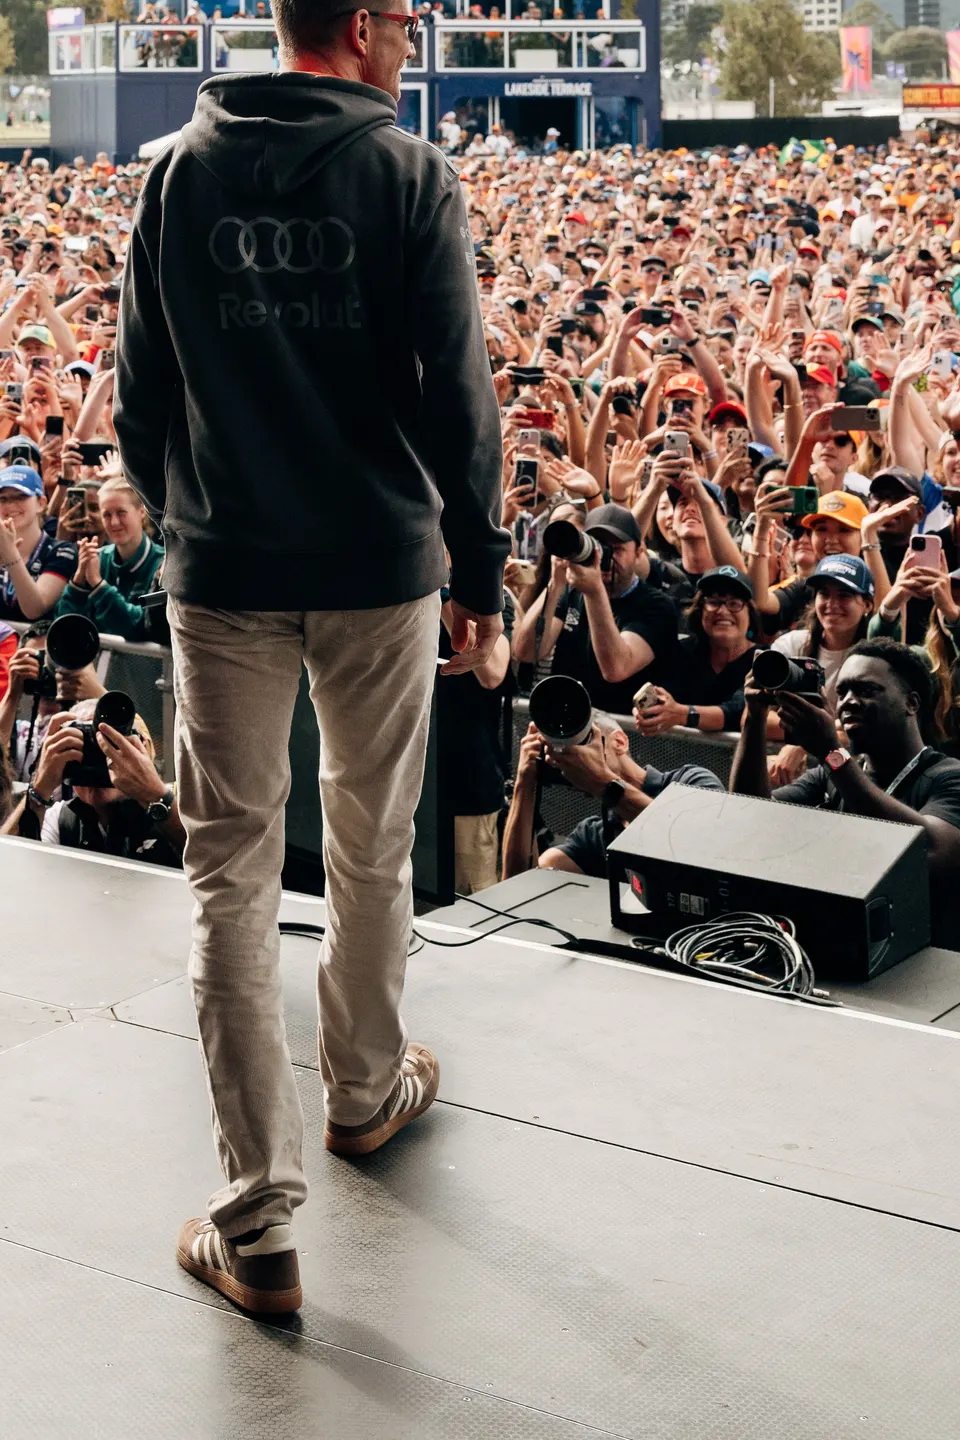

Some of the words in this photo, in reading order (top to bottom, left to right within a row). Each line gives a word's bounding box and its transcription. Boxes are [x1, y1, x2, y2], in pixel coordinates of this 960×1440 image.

[504, 82, 550, 96] LAKESIDE
[551, 82, 592, 96] TERRACE
[217, 290, 363, 330] Revolut
